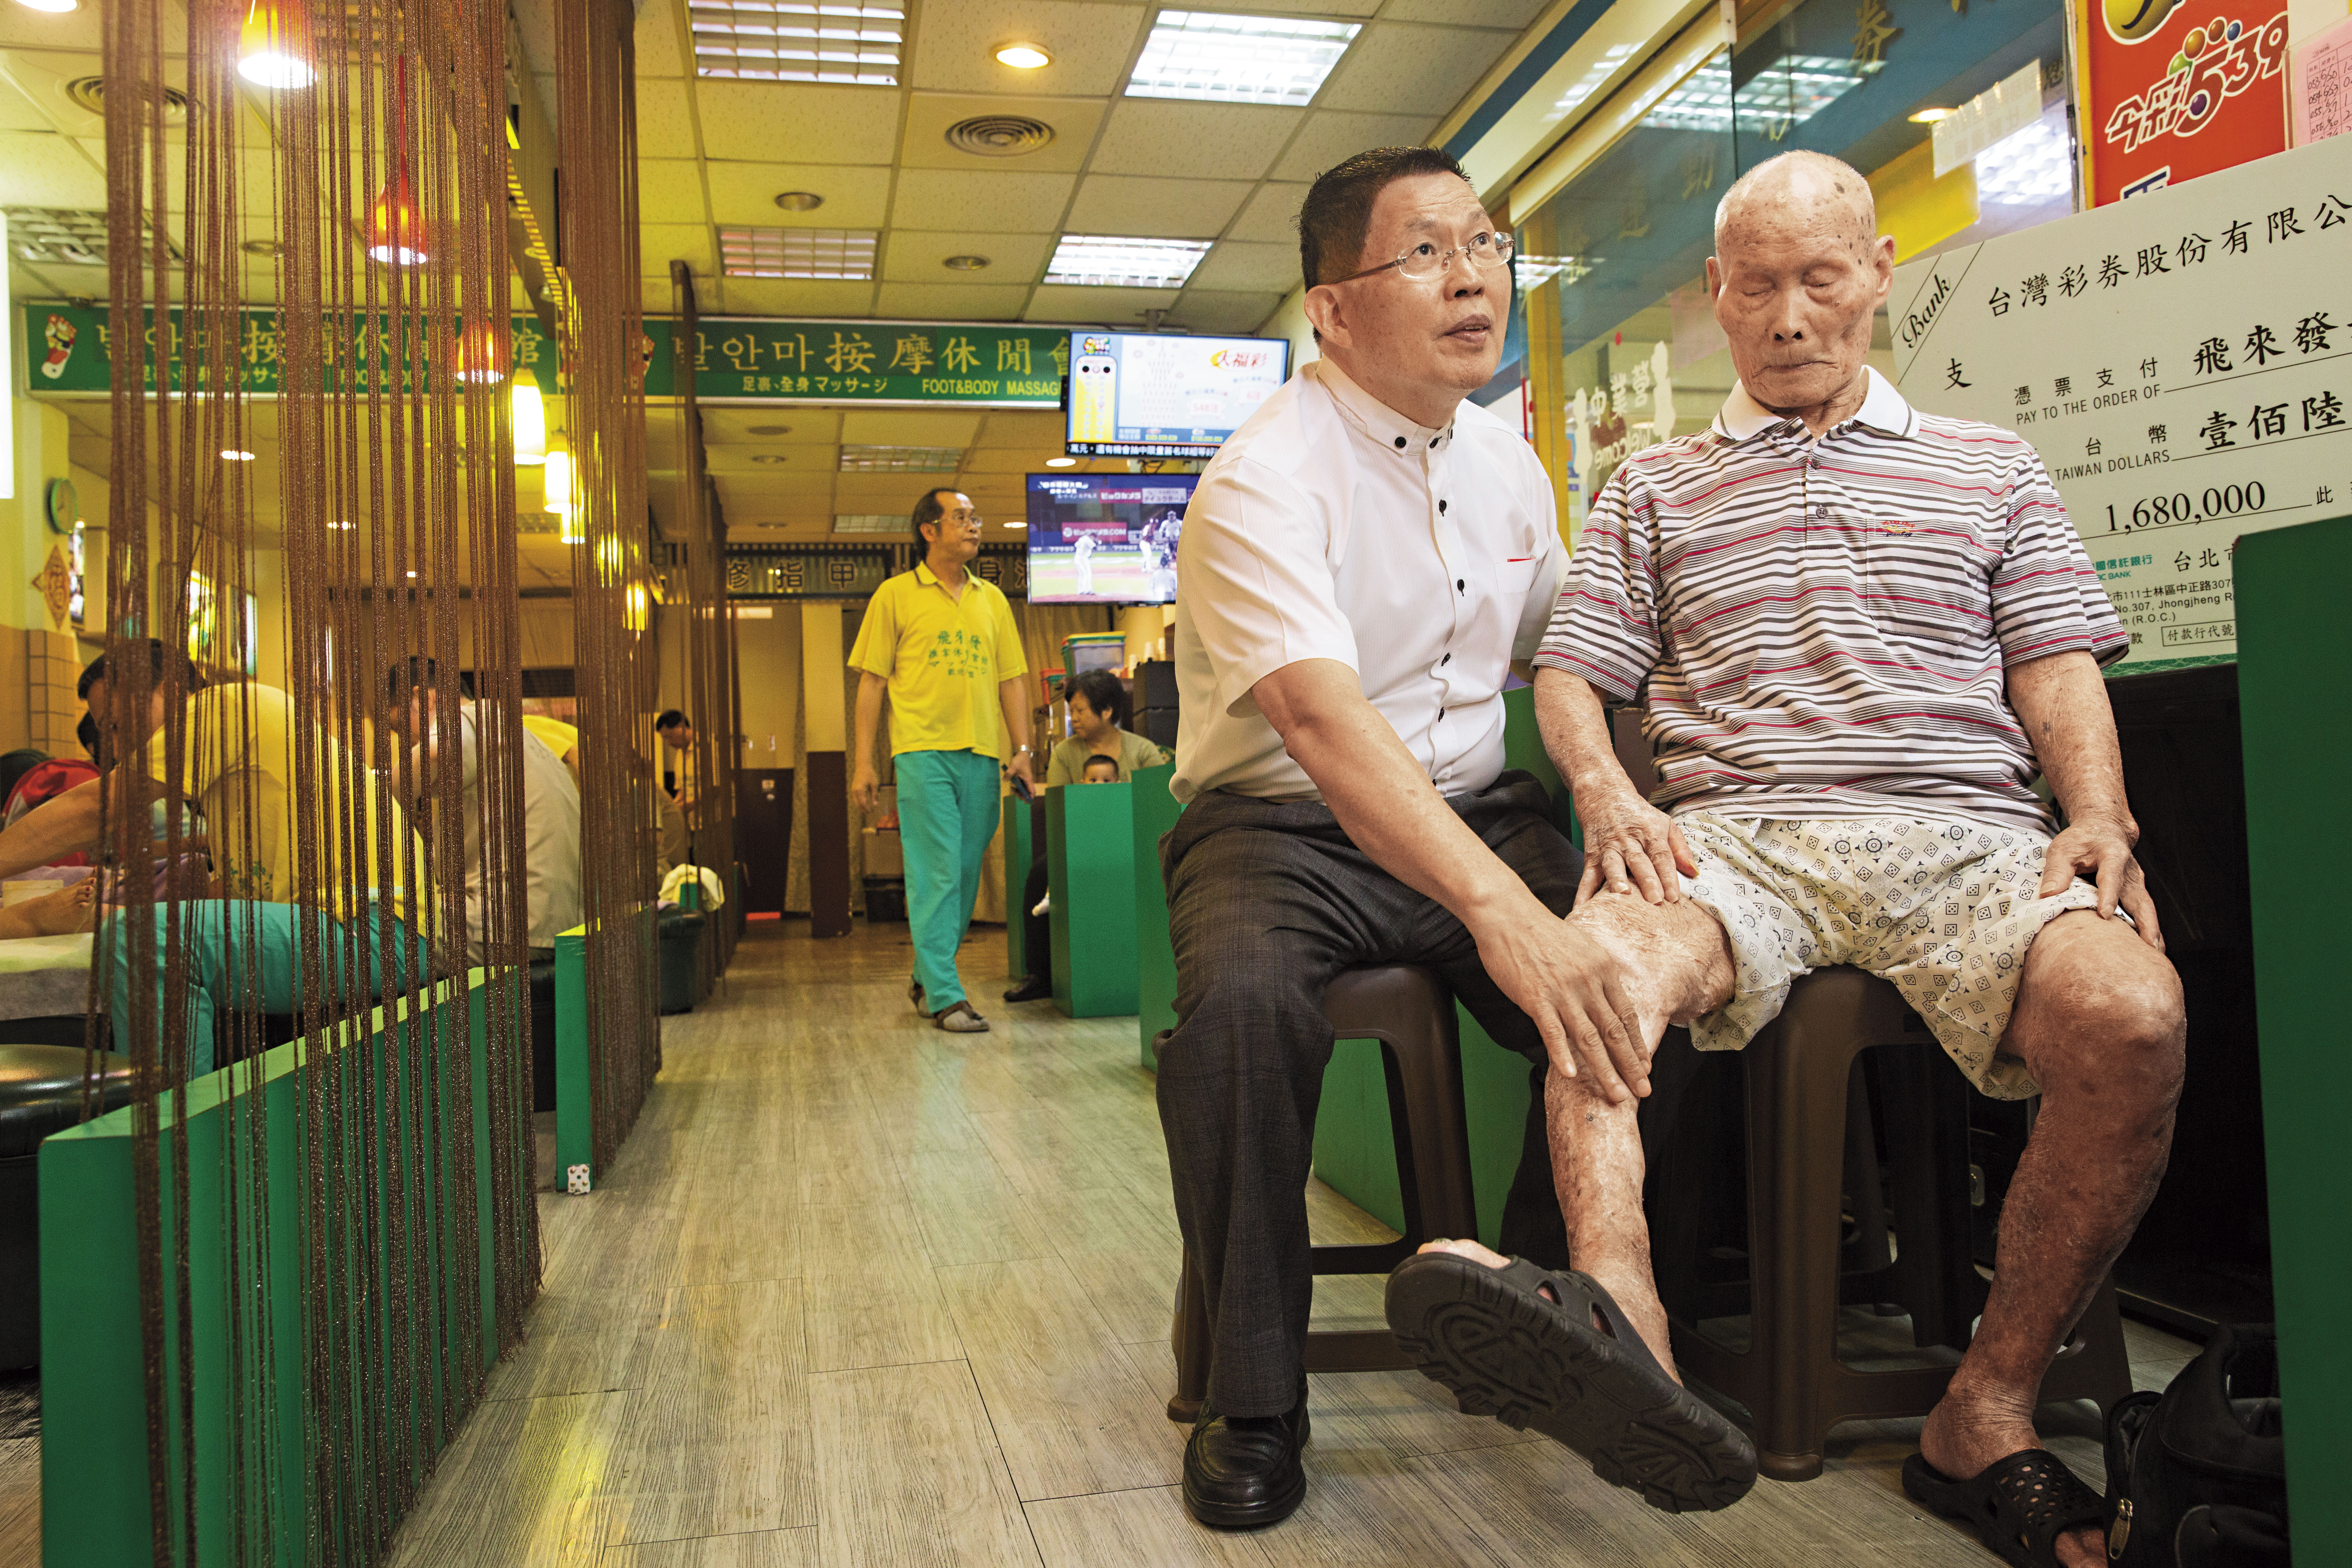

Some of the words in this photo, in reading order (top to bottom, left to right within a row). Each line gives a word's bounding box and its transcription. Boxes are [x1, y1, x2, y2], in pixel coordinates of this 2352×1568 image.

[1902, 274, 1951, 348] Bank
[2193, 312, 2352, 376] 飛來發
[922, 379, 999, 394] FOOT&BODY
[1007, 380, 1061, 396] MASSAG
[1945, 358, 1972, 390] 支
[2014, 357, 2158, 405] 憑票支付
[2016, 410, 2036, 425] PAY
[2042, 406, 2058, 419] TO
[2063, 399, 2087, 416] THE
[2093, 389, 2137, 409] ORDER
[2144, 384, 2160, 399] OF
[2055, 462, 2102, 481] TAIWAN
[2108, 450, 2170, 472] DOLLARS
[2105, 481, 2265, 535] 1,680,000
[2092, 555, 2153, 572] 國信託銀行
[2108, 570, 2132, 580] BANK
[2158, 595, 2220, 609] Jhongjheng
[2132, 612, 2176, 626] (R.O.C.)
